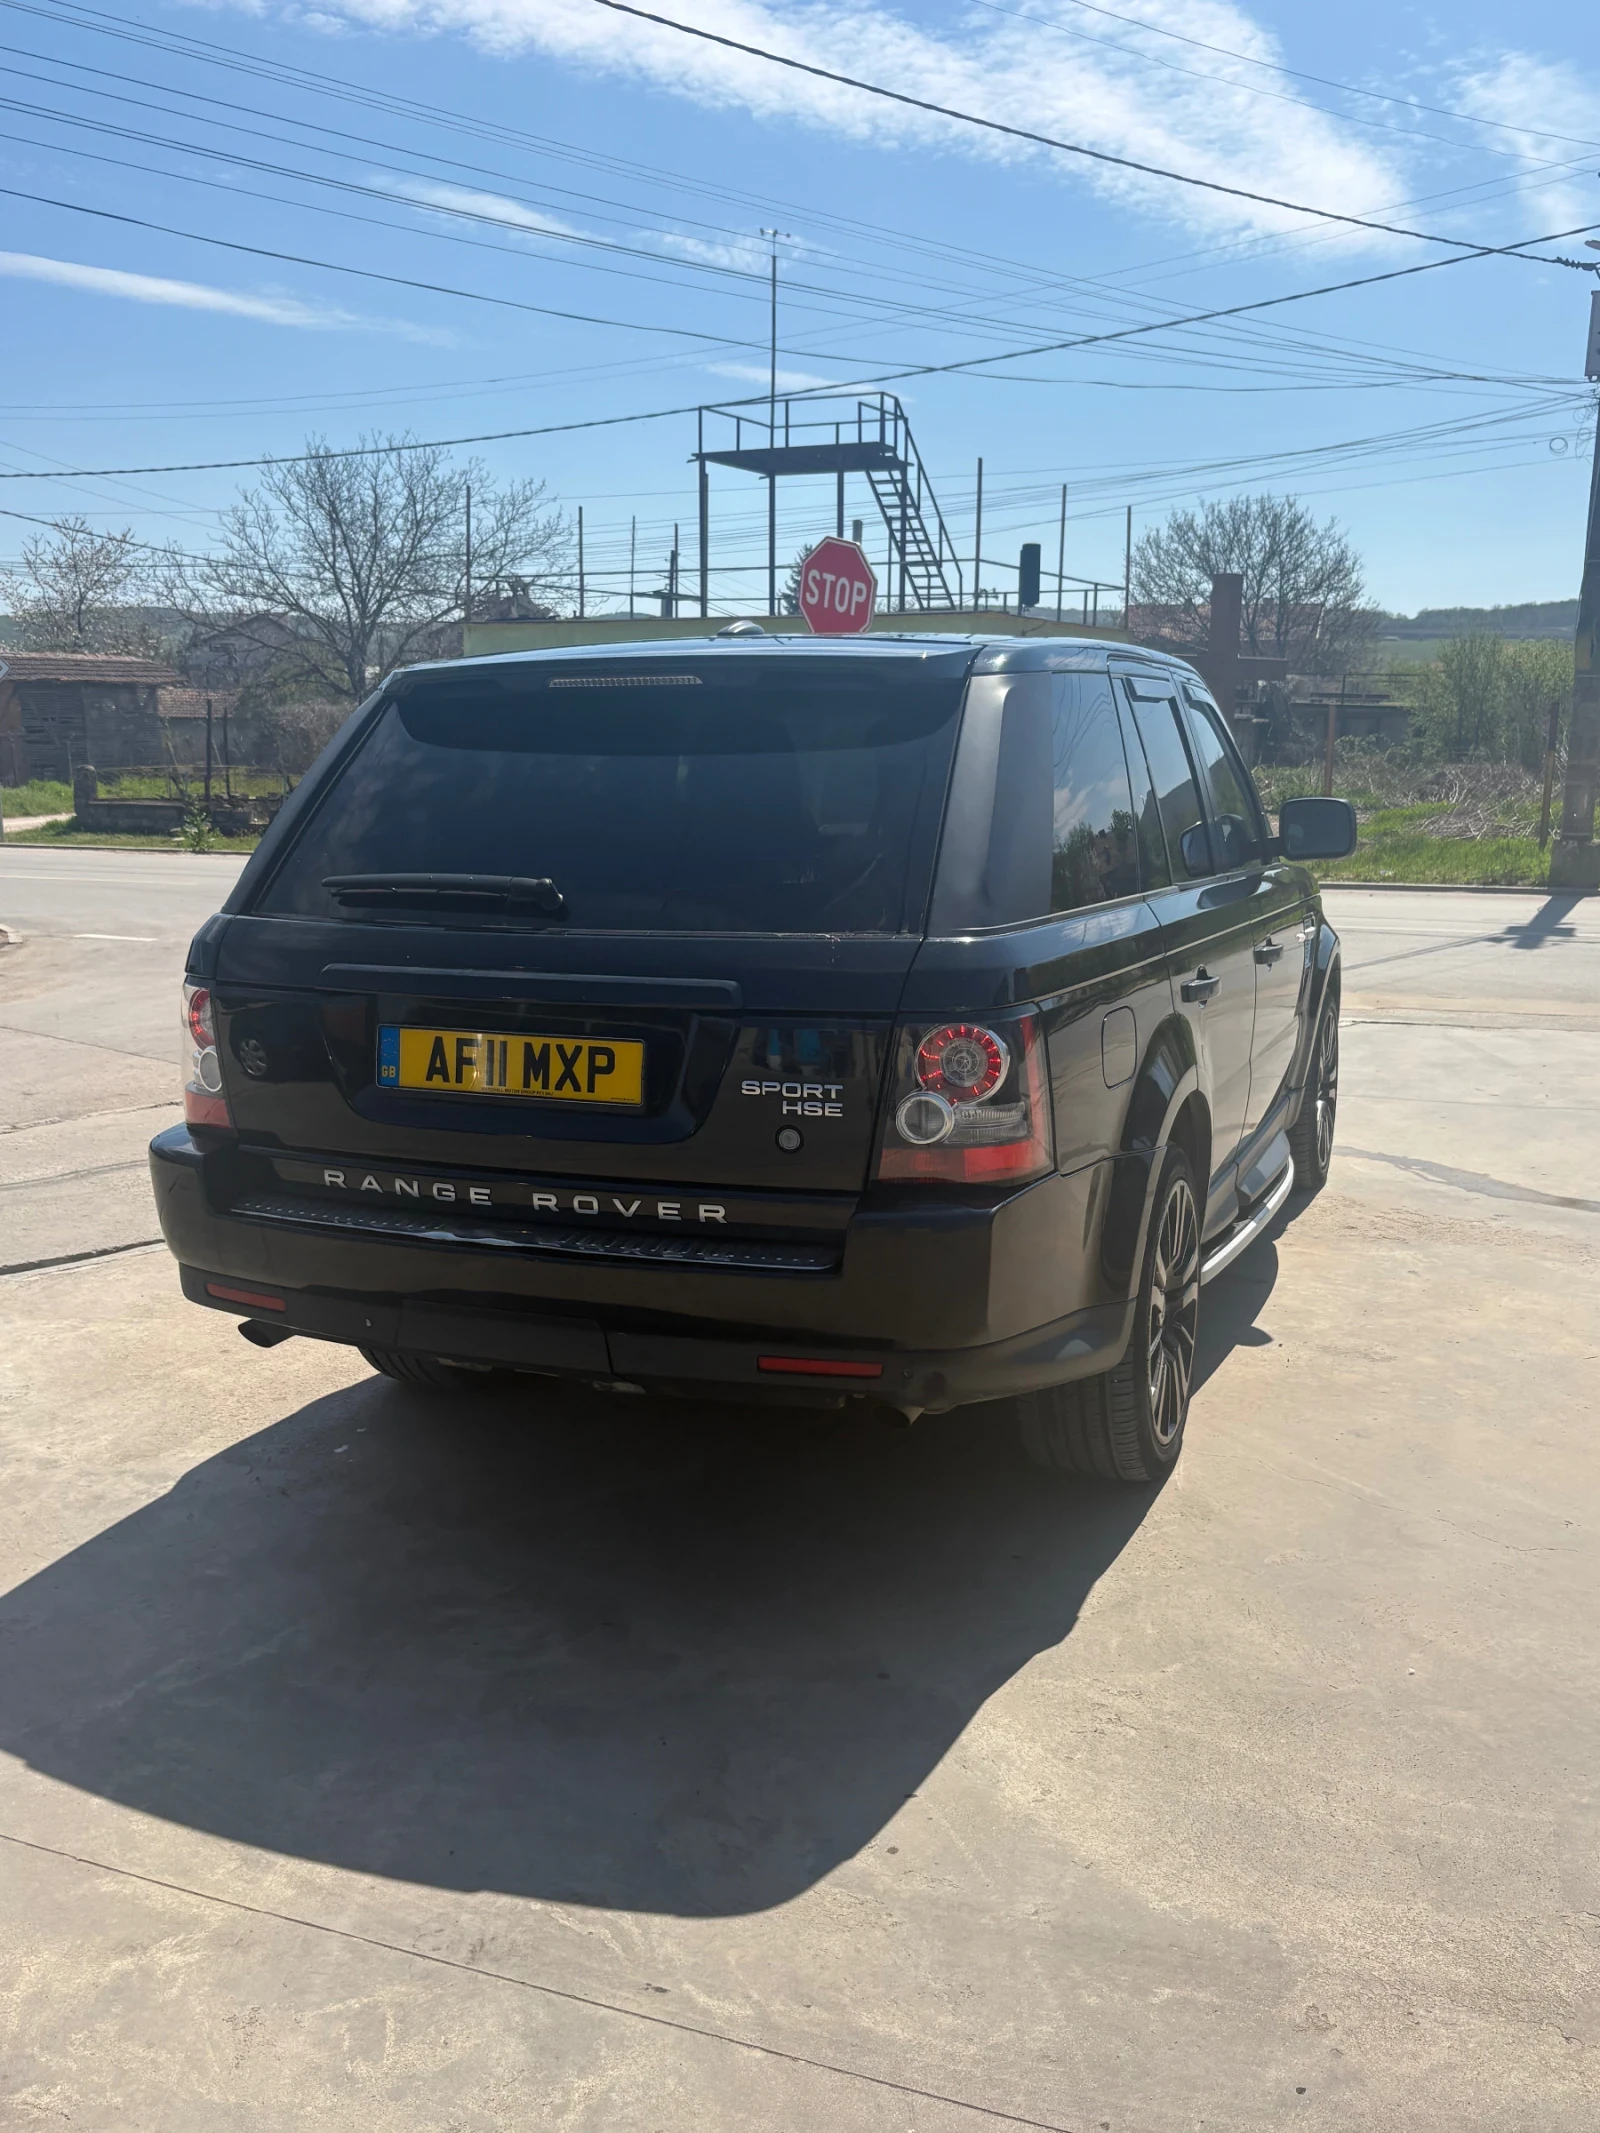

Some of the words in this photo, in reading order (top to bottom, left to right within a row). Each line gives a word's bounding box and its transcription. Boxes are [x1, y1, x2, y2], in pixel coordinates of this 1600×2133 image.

[805, 569, 867, 616] STOP
[381, 1065, 396, 1078] GB
[425, 1035, 508, 1087] AF11
[522, 1041, 616, 1094] MXP
[741, 1080, 844, 1099] SPORT
[782, 1100, 843, 1117] HSE
[323, 1169, 492, 1205] RANGE
[532, 1192, 727, 1224] ROVER
